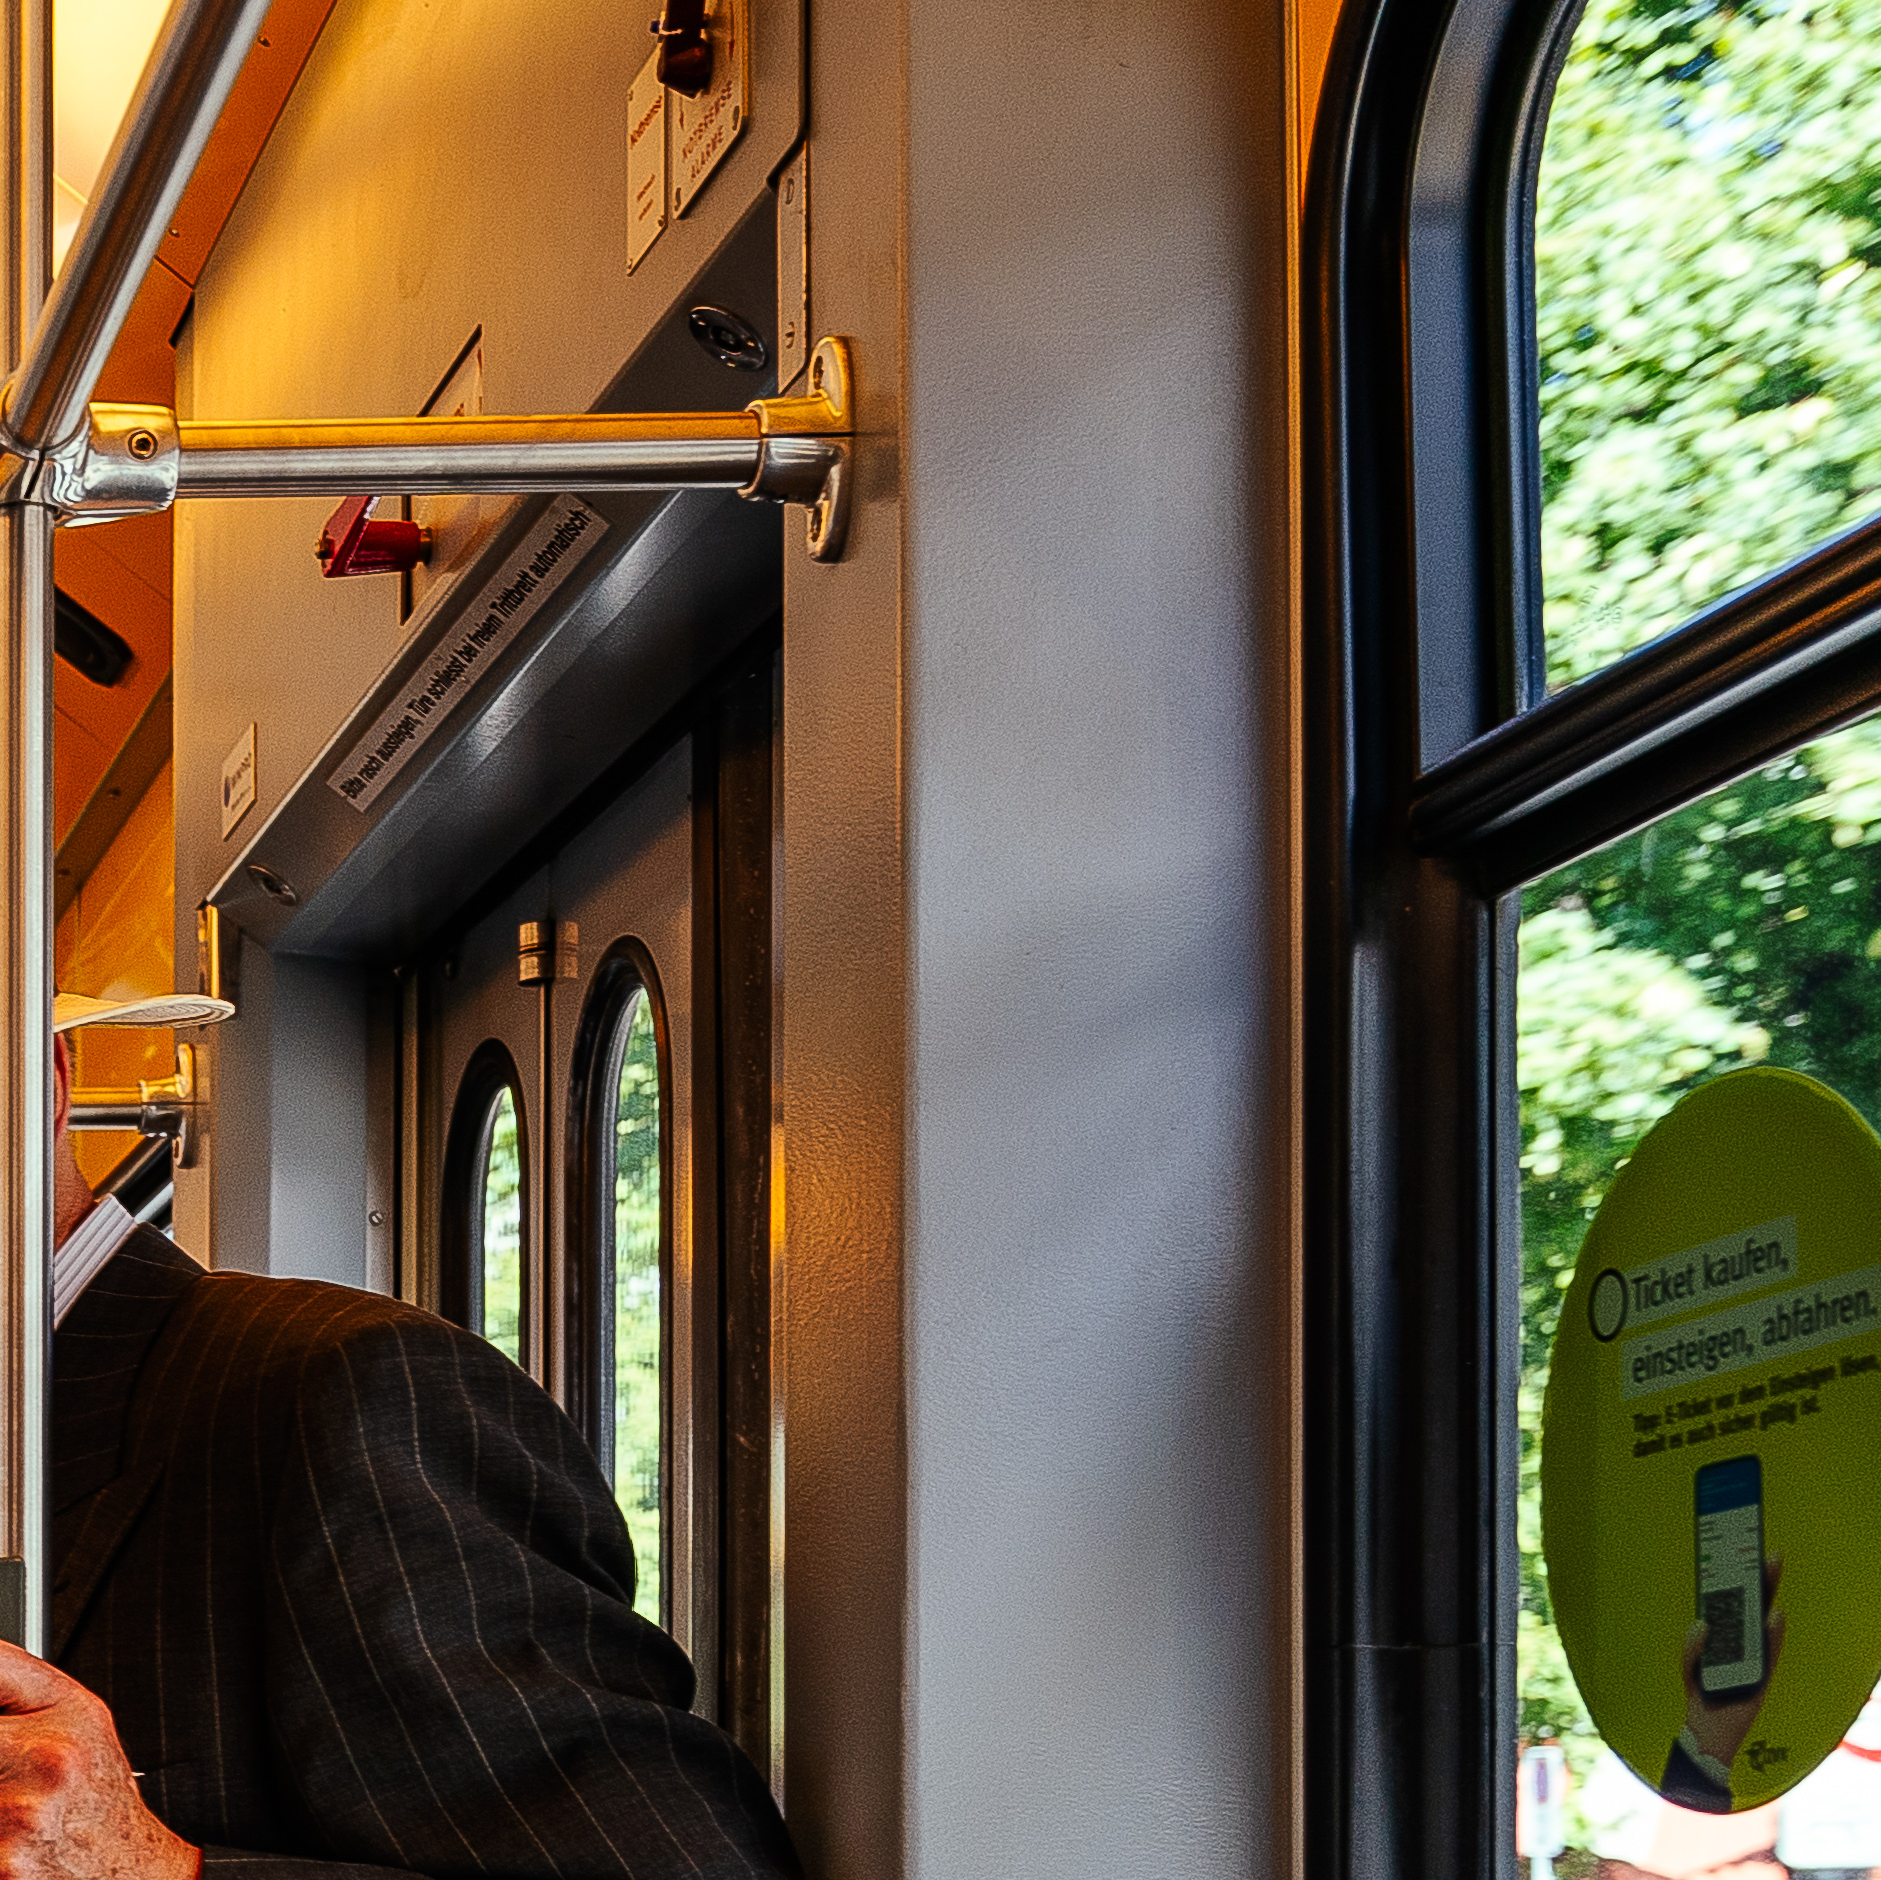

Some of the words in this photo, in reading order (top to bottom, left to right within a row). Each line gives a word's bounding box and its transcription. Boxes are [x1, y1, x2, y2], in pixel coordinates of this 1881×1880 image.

[529, 507, 593, 580] automatisch
[490, 569, 539, 619] Trittbrett
[453, 638, 481, 664] bei
[466, 612, 506, 650] freiem
[426, 653, 469, 700] schliesst
[376, 714, 425, 762] aussteigen,
[339, 776, 367, 799] Bitte
[357, 753, 385, 783] rasch
[1631, 1262, 1696, 1312] Ticket
[1703, 1238, 1789, 1291] kaufen,
[1632, 1327, 1755, 1384] einsteigen,
